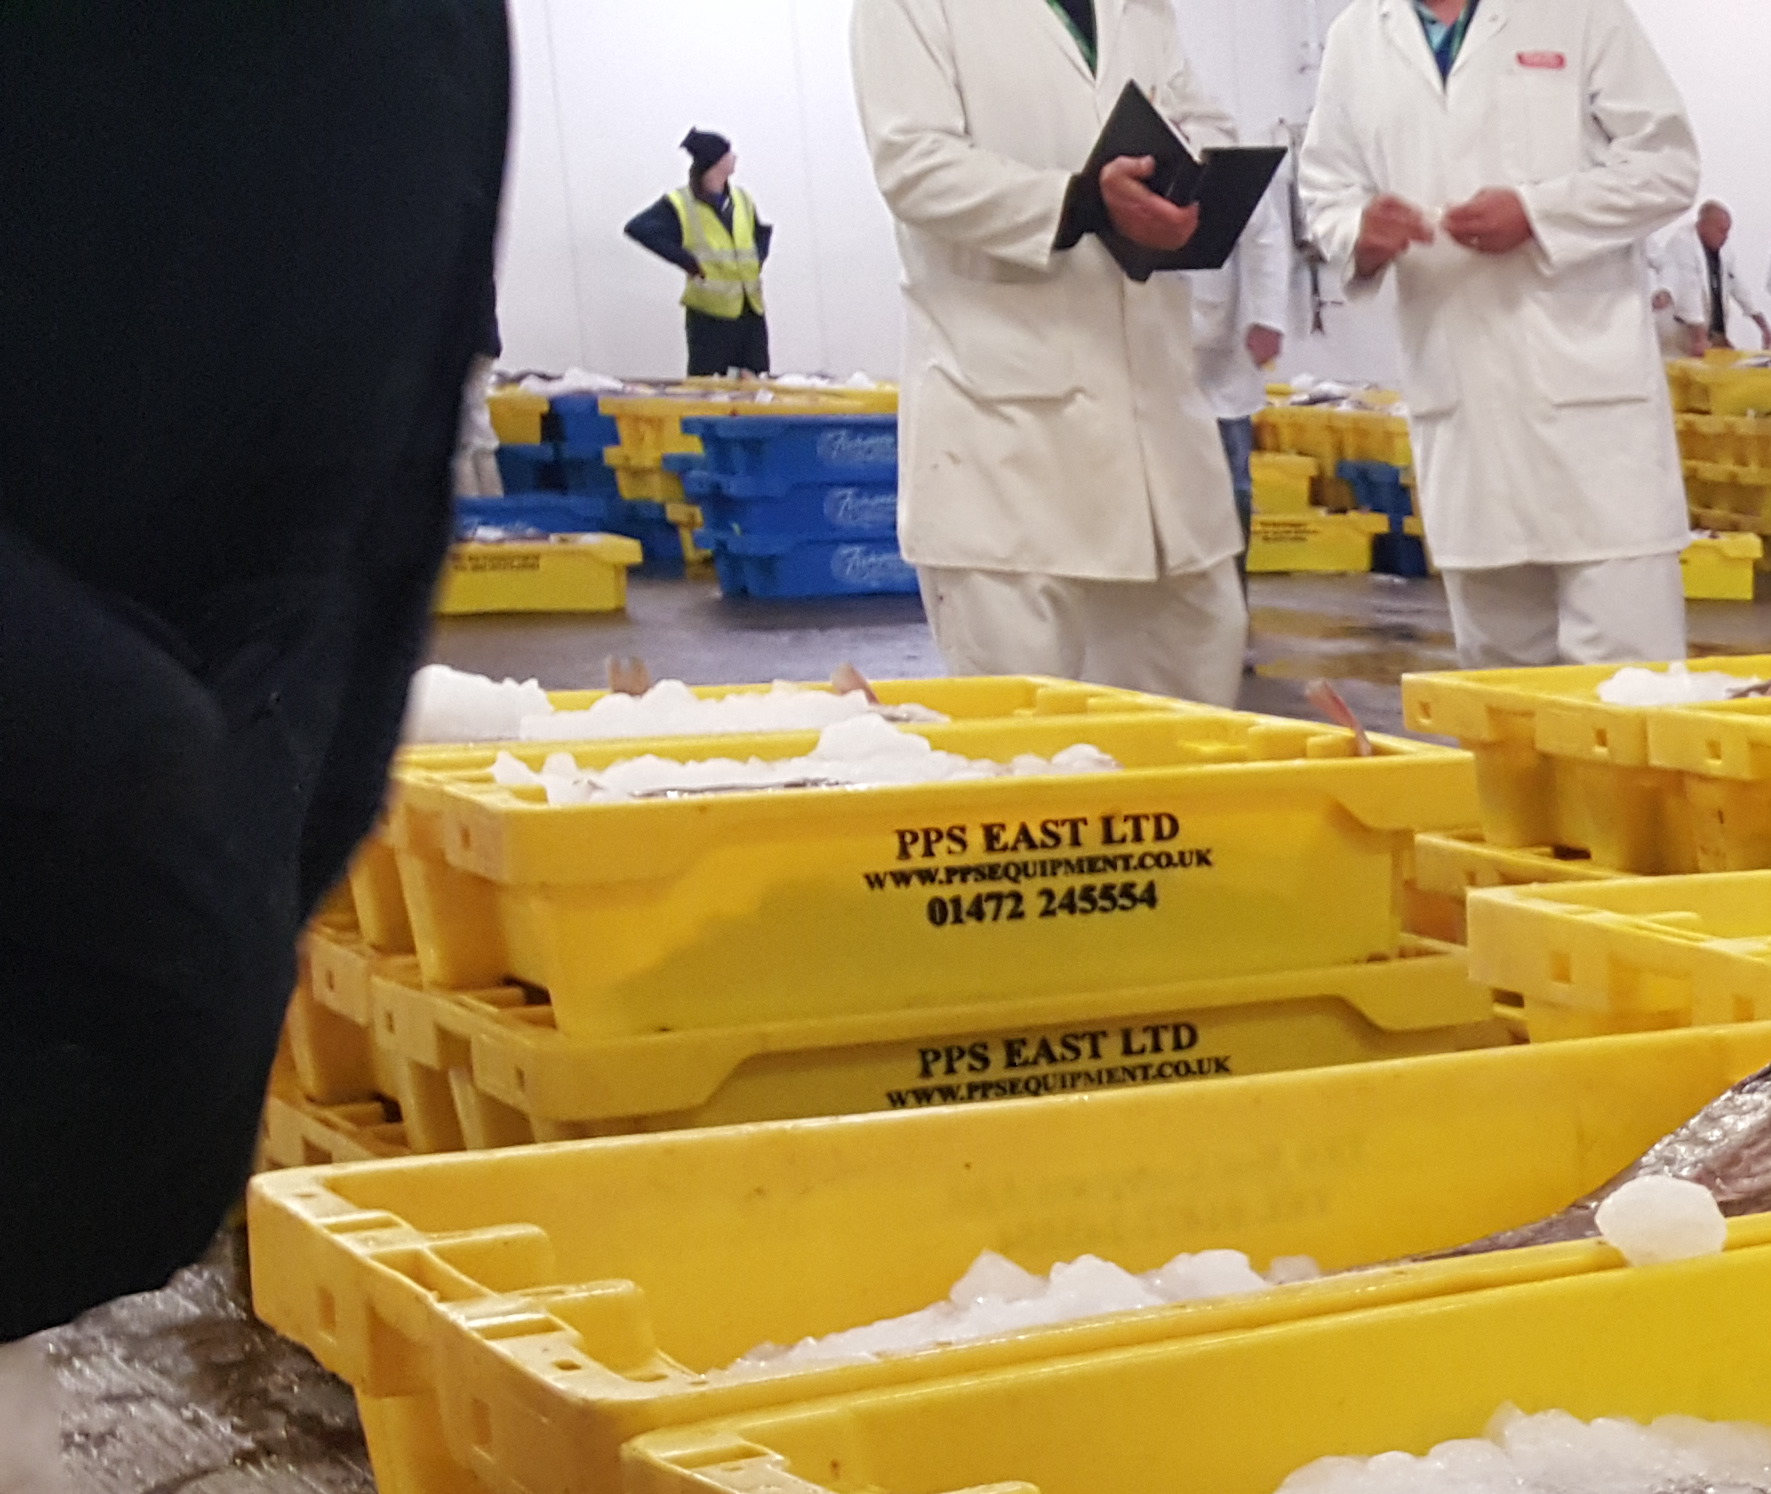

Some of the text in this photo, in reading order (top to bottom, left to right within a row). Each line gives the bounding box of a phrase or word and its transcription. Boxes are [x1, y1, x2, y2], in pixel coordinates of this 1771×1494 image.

[895, 812, 1180, 860] PPS EAST LTD
[864, 848, 1212, 891] WWW.PPSEQUIPMENT.CO.UK
[927, 880, 1159, 927] 01472 245554
[917, 1022, 1199, 1079] PPS EAST LTD
